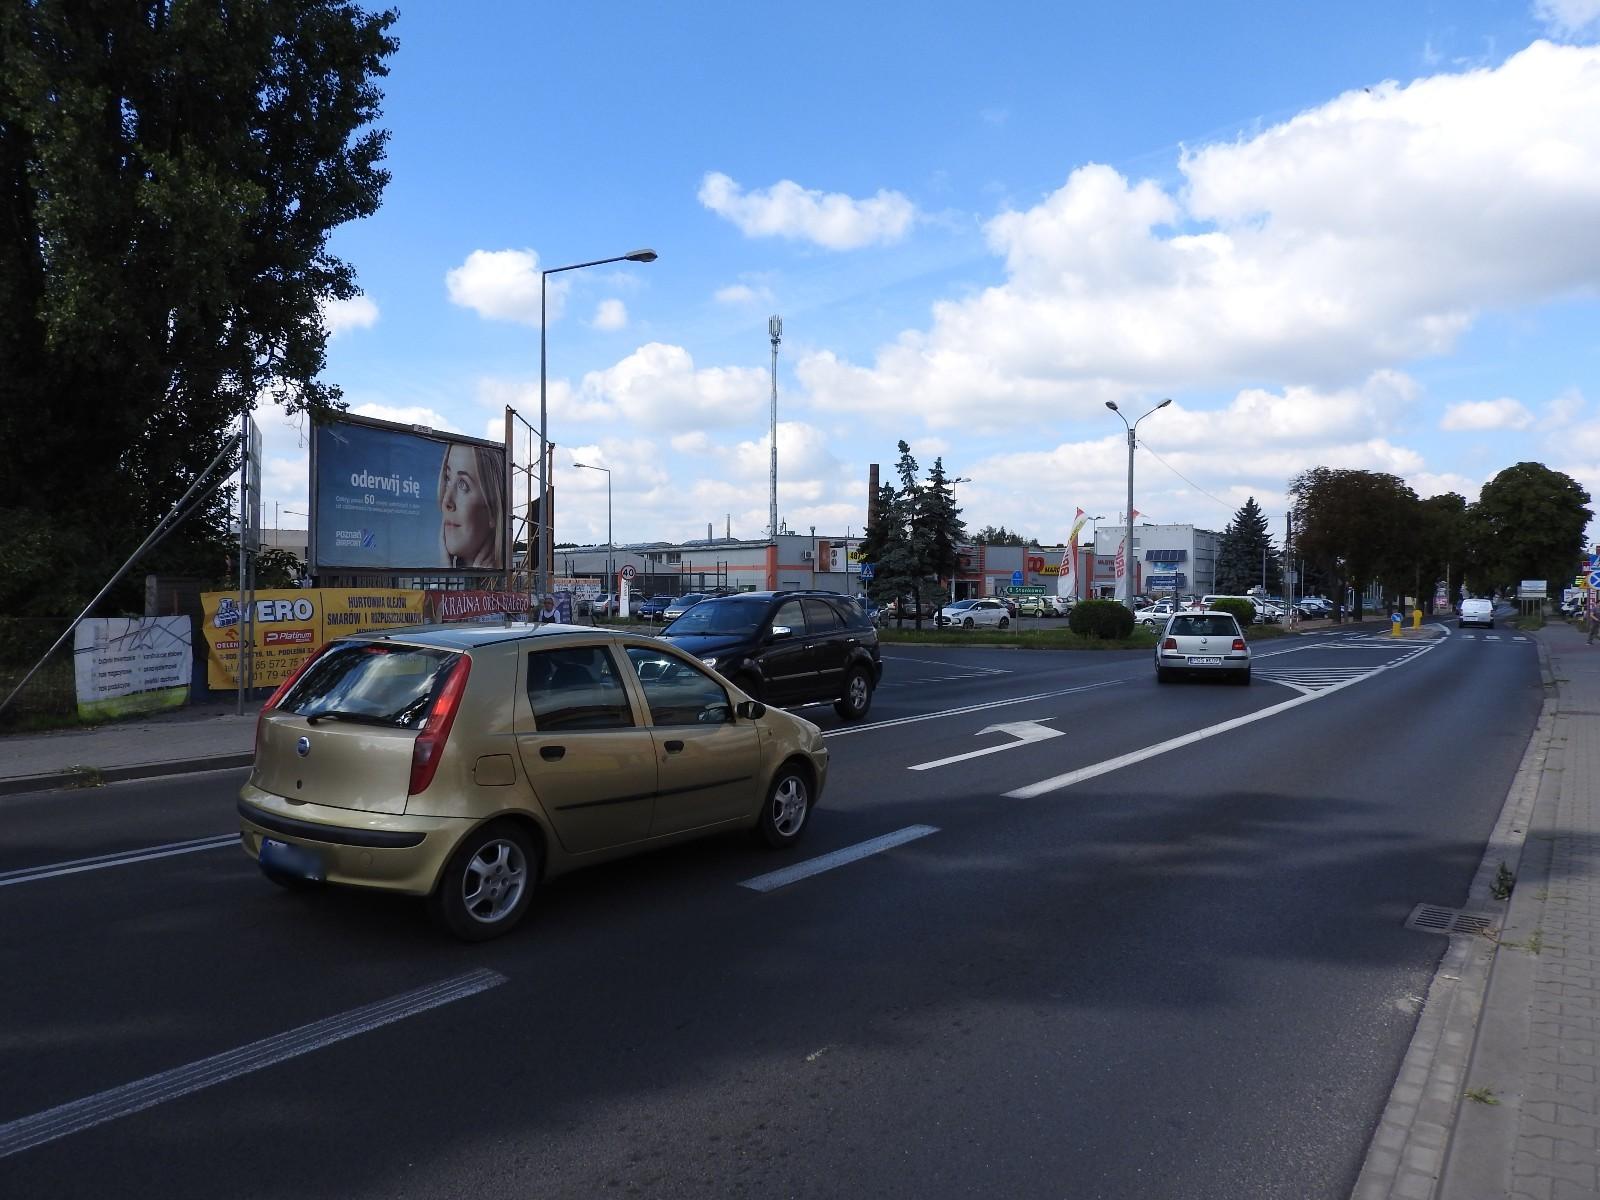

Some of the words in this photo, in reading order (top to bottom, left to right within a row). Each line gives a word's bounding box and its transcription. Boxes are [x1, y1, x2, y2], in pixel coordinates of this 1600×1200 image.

[351, 470, 400, 496] oderwij
[403, 476, 420, 498] się
[364, 494, 375, 505] 60
[622, 568, 634, 577] 40
[442, 593, 480, 616] KRAINA
[327, 609, 361, 625] SMARÓW
[279, 632, 312, 641] Platinum
[217, 641, 240, 649] ORLEN
[255, 660, 266, 669] 65
[269, 659, 286, 668] 572
[266, 670, 278, 679] 79
